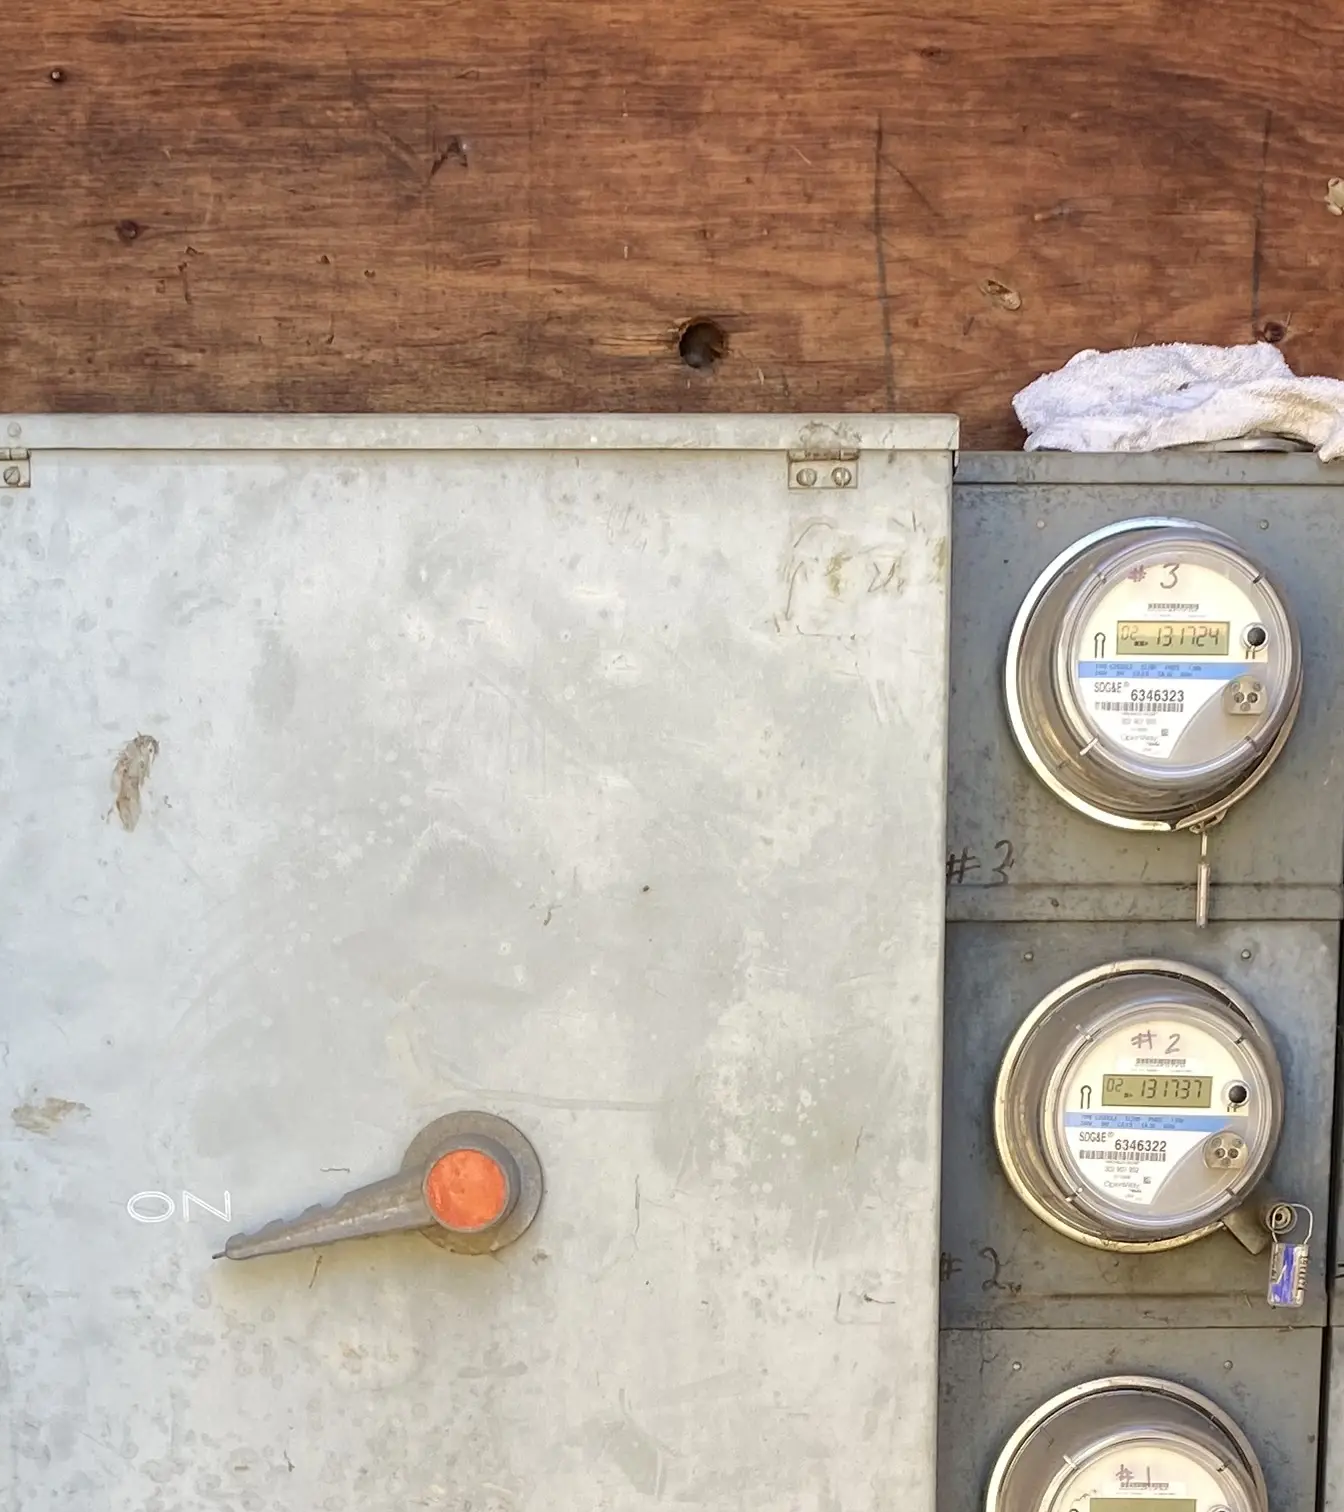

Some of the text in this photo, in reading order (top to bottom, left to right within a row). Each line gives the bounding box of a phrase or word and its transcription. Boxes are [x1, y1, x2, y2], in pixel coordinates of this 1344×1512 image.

[1130, 689, 1185, 702] 6346323
[1114, 1139, 1167, 1152] 6346322
[126, 1190, 232, 1224] ON
